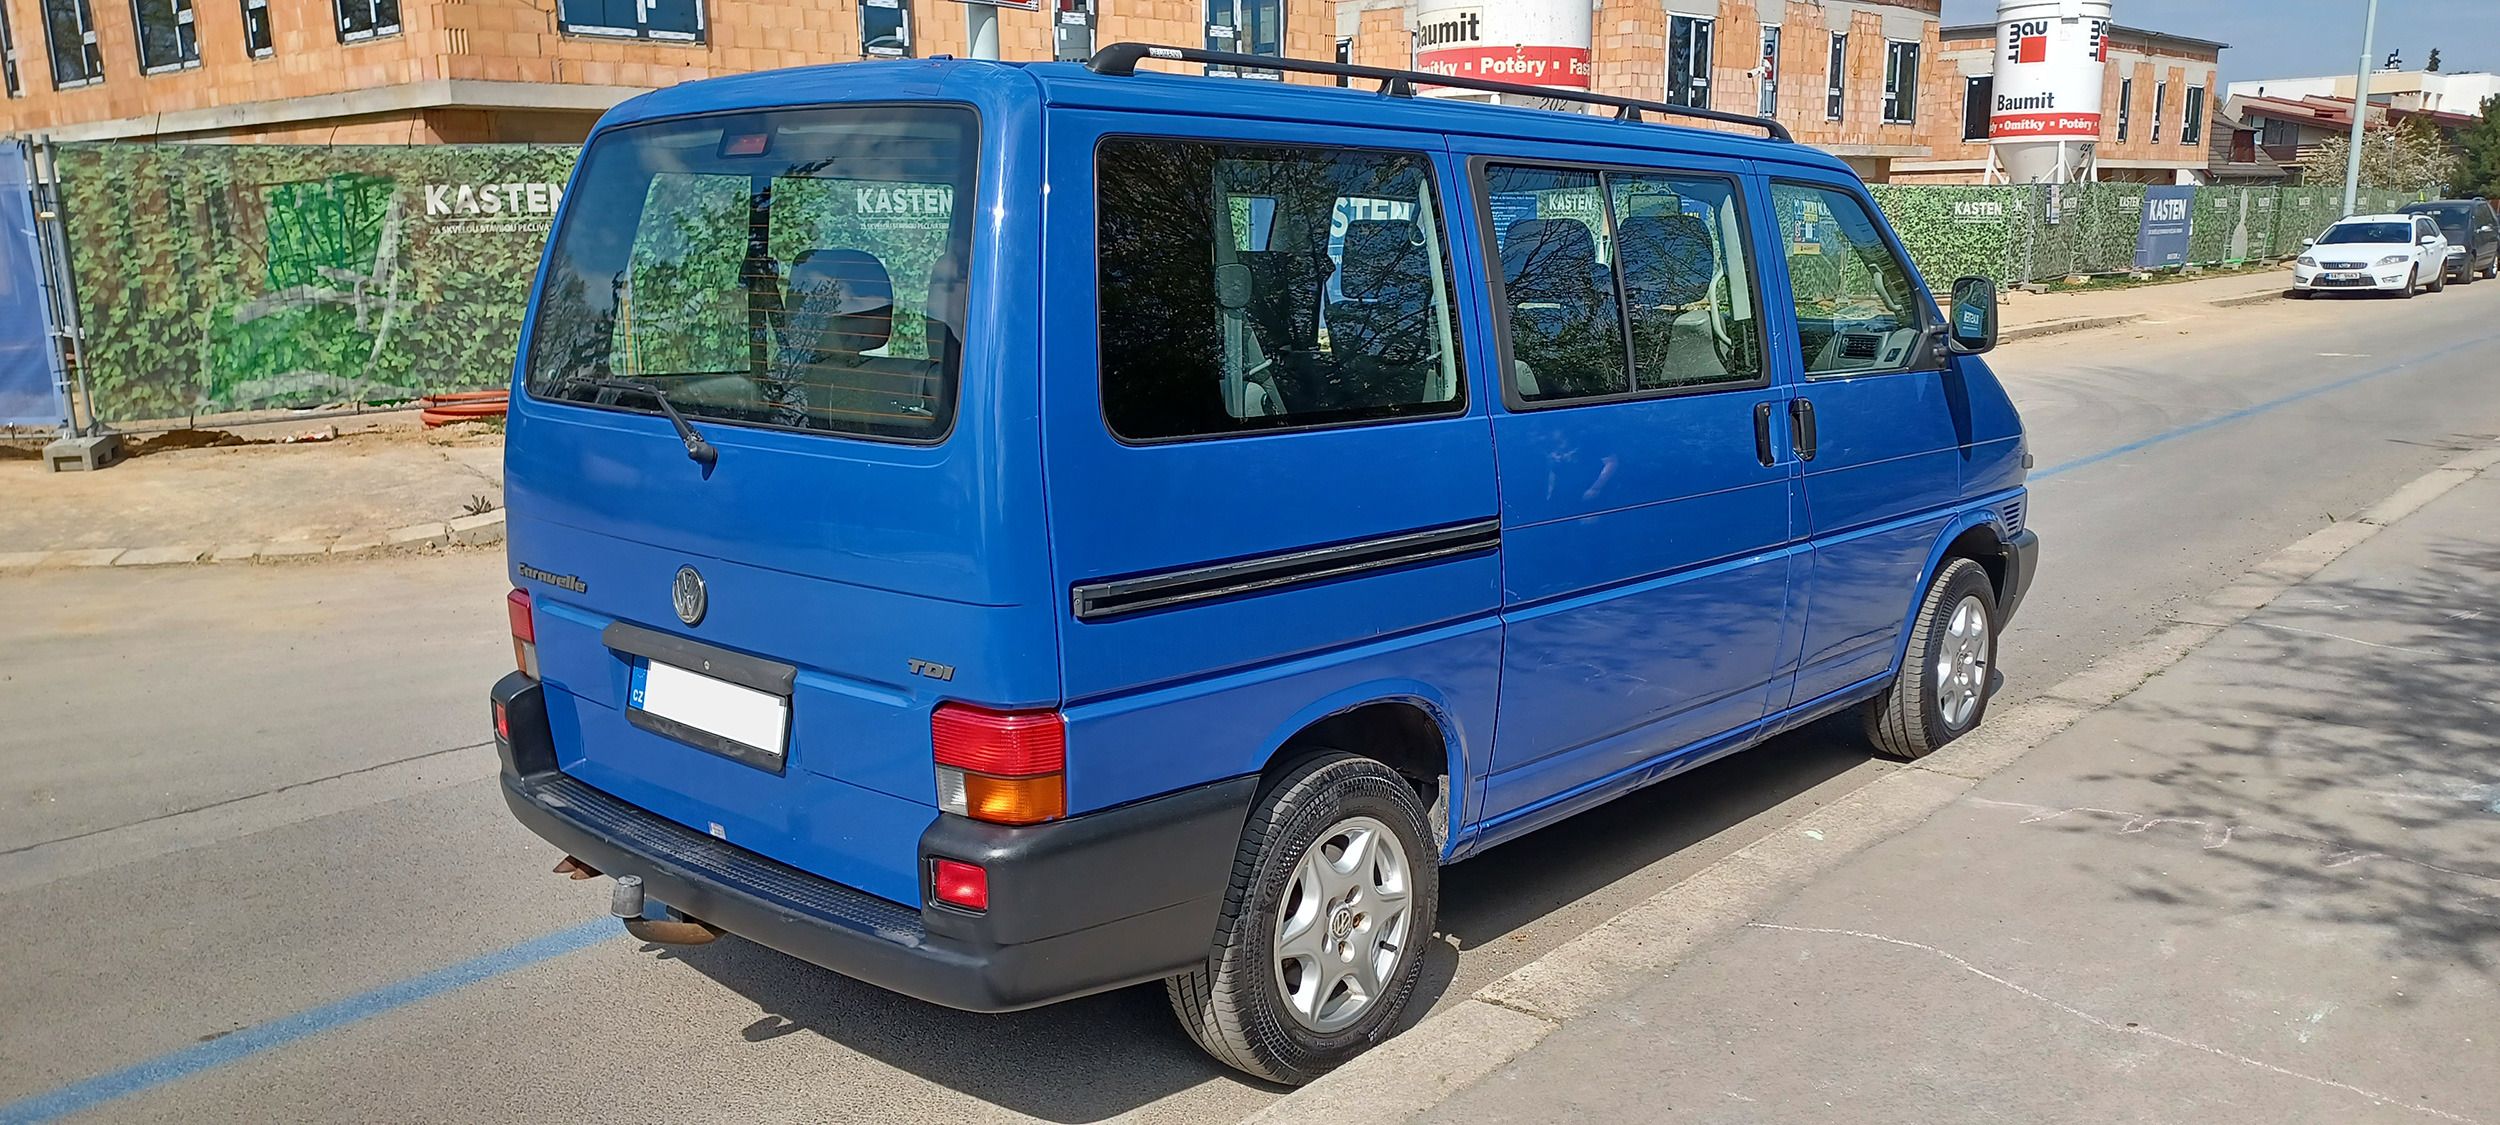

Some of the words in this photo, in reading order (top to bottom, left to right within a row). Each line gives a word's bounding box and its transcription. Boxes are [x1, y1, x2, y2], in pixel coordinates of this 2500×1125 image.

[1480, 54, 1547, 77] Potěry
[1997, 92, 2055, 111] Baumit
[2004, 118, 2046, 131] Omítky
[2059, 117, 2093, 130] Potěry
[857, 188, 954, 214] KASTEN
[1549, 194, 1593, 211] KASTEN
[1955, 200, 2003, 216] KASTEN
[2149, 199, 2187, 221] KASTEN
[1331, 197, 1410, 238] STEN
[907, 658, 955, 682] TDI
[632, 688, 644, 703] CZ
